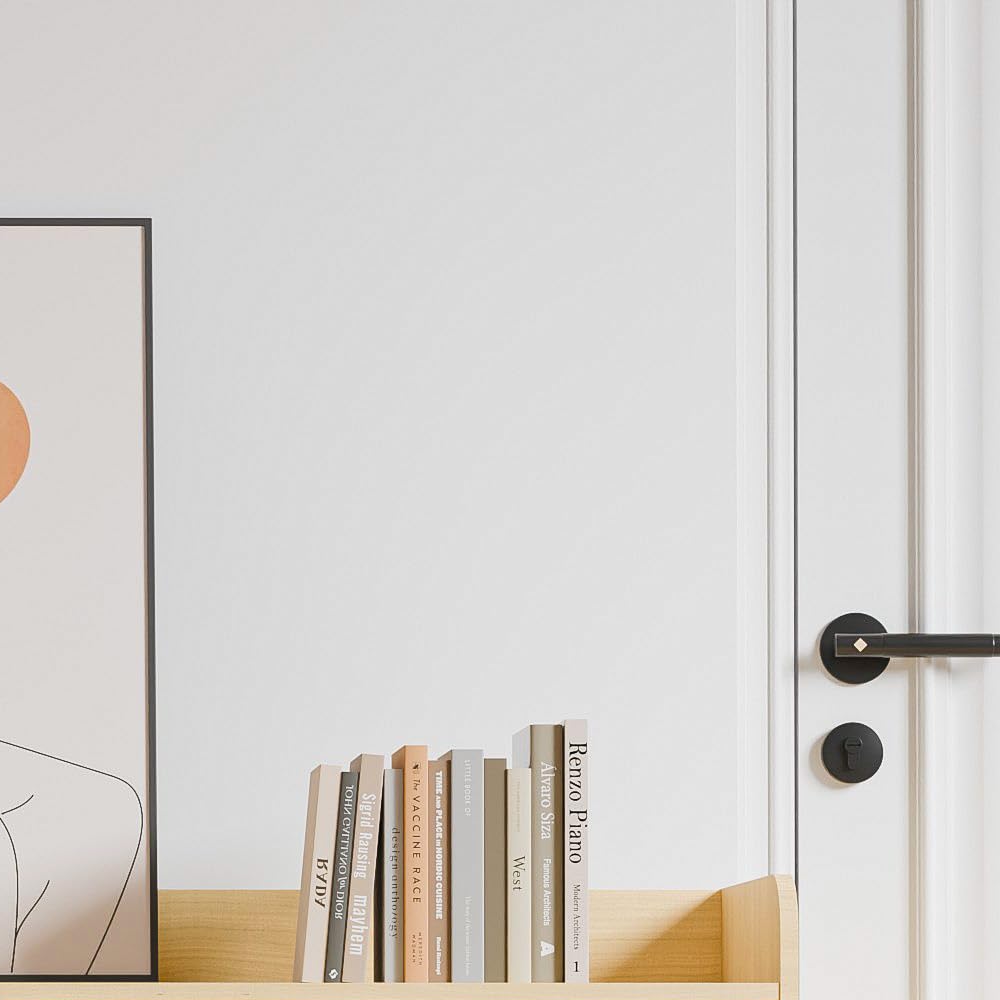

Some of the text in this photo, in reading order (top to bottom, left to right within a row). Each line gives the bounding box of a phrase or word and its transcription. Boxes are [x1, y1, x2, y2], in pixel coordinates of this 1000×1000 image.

[435, 770, 443, 795] TIME
[540, 761, 557, 840] Álvaro Siza
[568, 741, 588, 864] Renzo Piano
[353, 793, 376, 879] Sigrid Rausing
[389, 827, 401, 870] design
[412, 778, 421, 904] The VACCINE RACE
[435, 809, 443, 839] PLACE
[435, 847, 443, 882] NORDIC
[512, 855, 526, 892] West
[543, 858, 552, 926] Famous Architects
[348, 895, 368, 956] mayhem
[435, 882, 443, 920] CUISINE
[573, 884, 581, 950] Modern Architects
